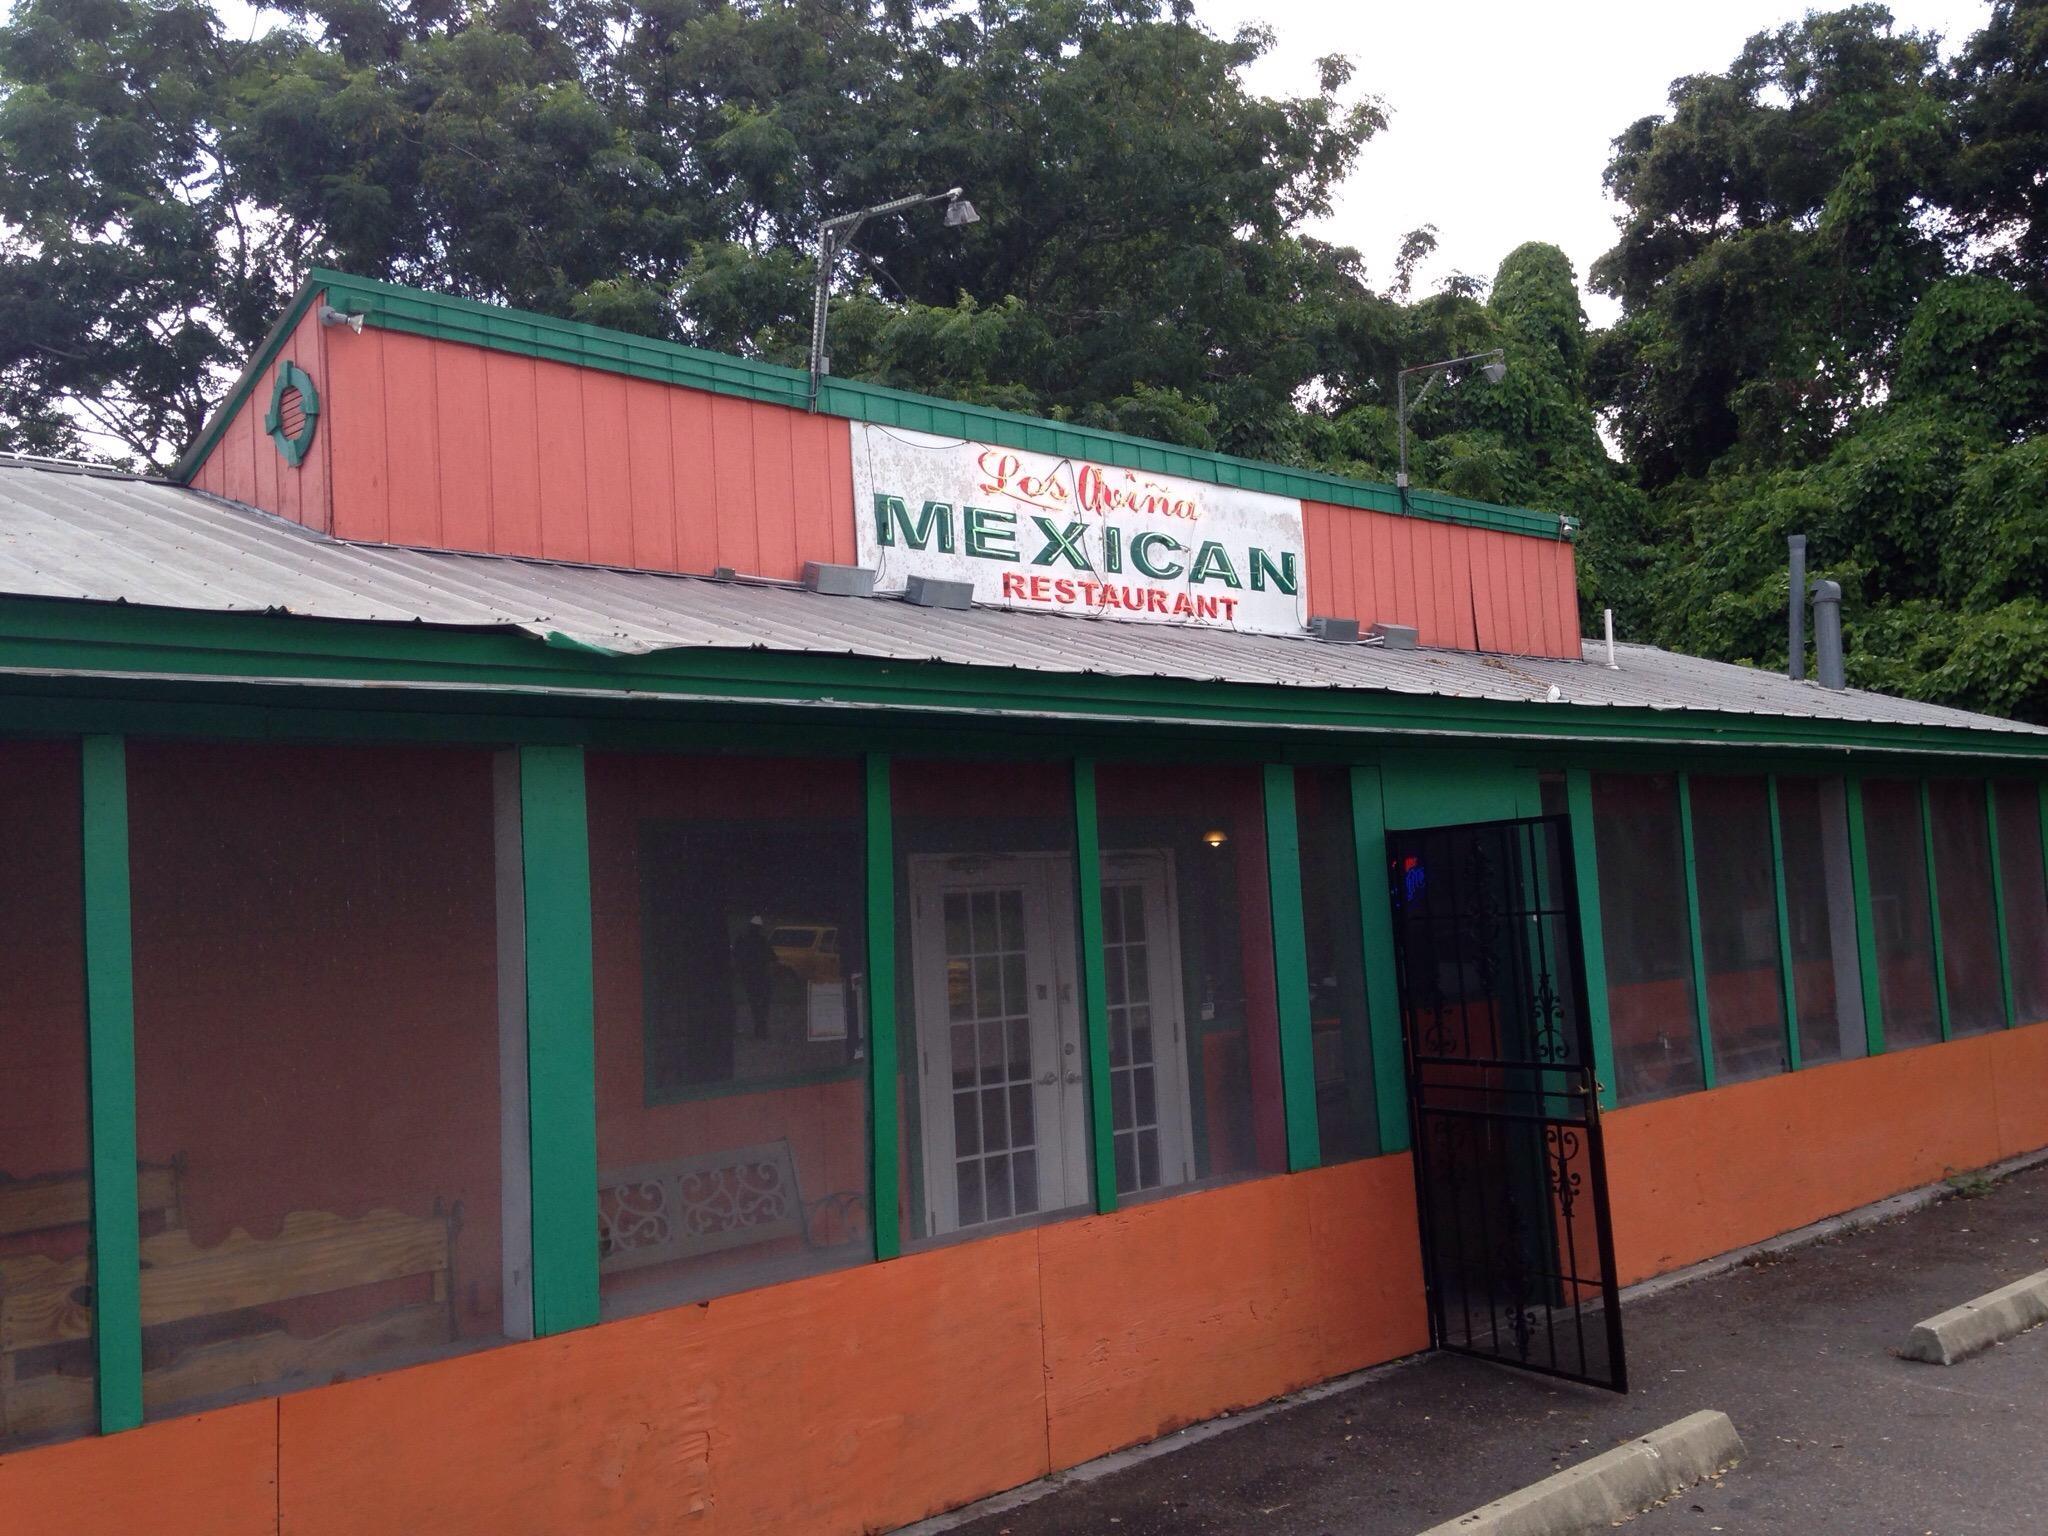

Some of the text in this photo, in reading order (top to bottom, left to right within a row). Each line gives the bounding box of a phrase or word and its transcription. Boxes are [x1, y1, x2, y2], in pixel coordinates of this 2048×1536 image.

[977, 450, 1069, 512] Los
[873, 493, 1298, 596] MEXICAN
[1002, 571, 1239, 621] RESTAURANT
